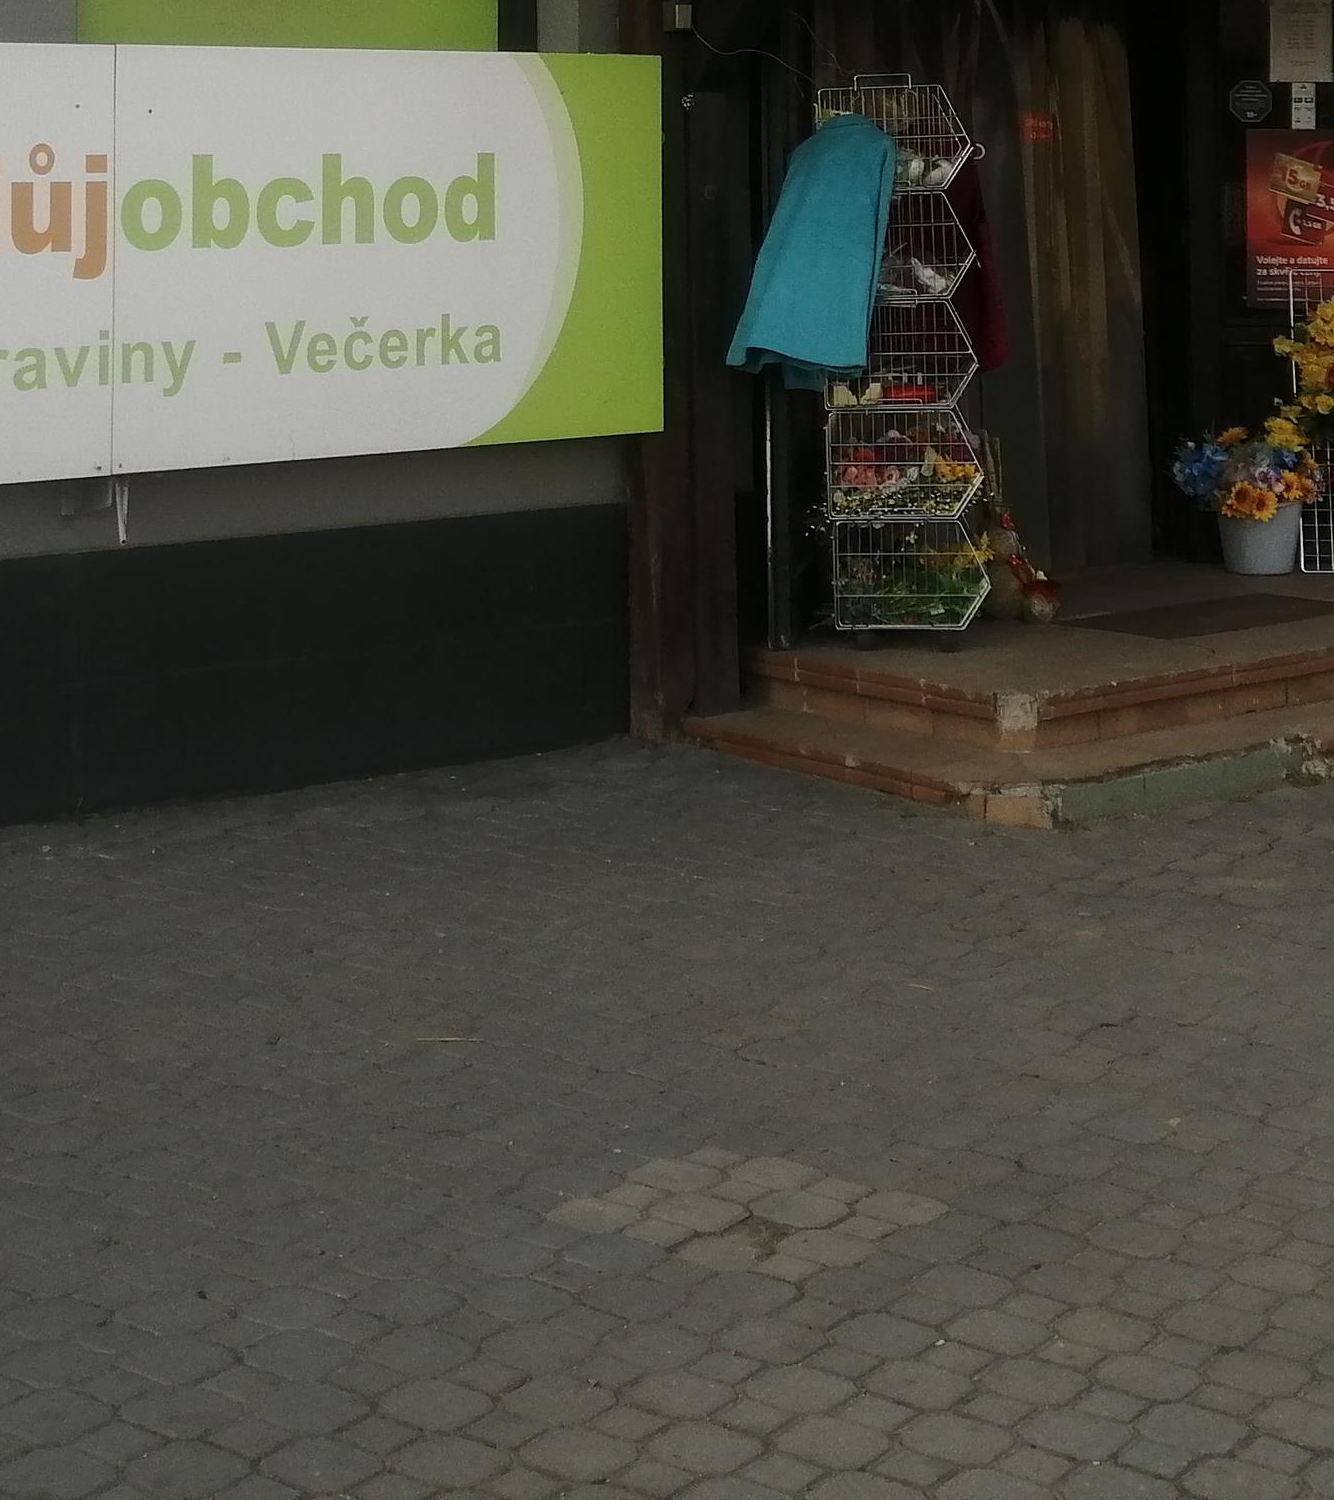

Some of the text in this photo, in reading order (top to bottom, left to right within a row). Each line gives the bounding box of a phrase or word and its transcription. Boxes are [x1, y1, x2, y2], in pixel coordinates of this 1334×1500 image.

[1256, 255, 1288, 266] Volejte
[1296, 255, 1329, 266] datujte
[1256, 268, 1268, 276] za
[266, 312, 504, 378] Večerka
